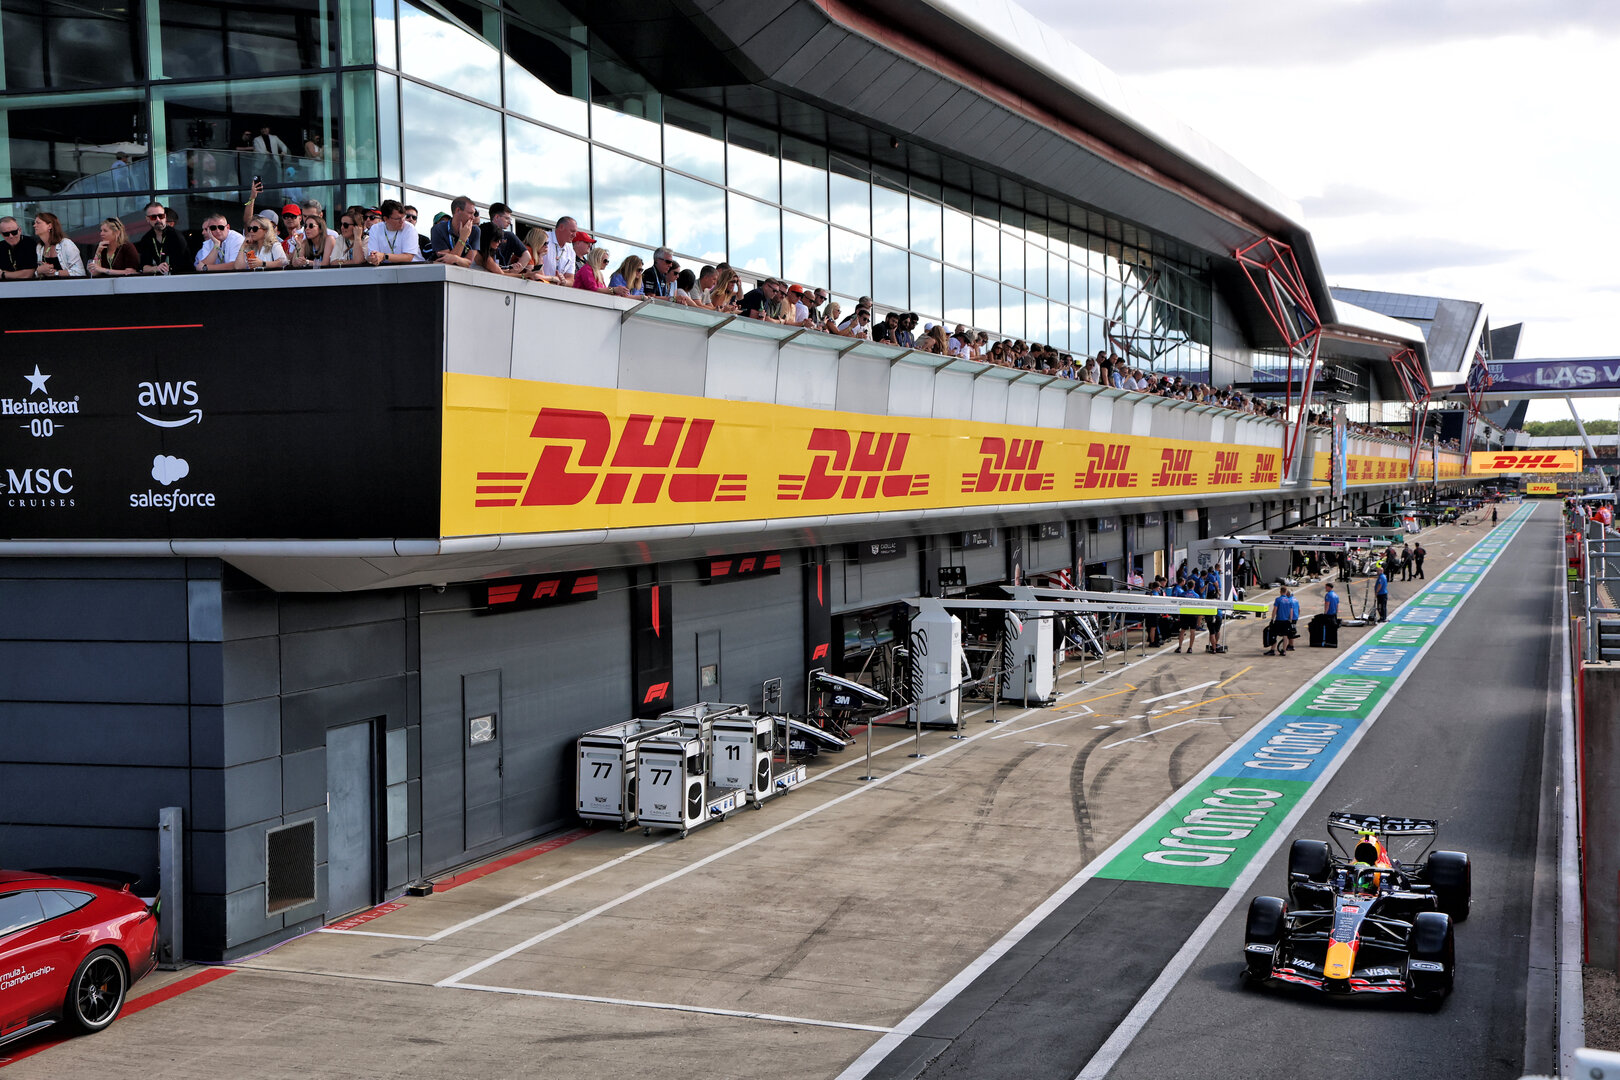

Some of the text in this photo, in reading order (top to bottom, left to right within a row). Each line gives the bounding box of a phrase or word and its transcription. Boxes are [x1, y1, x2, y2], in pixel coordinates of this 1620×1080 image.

[1536, 366, 1597, 385] LAS
[138, 380, 199, 406] aws
[1, 396, 79, 414] Heineken
[31, 418, 54, 437] 0.0
[520, 407, 719, 506] DHL
[801, 428, 913, 500] DHL
[975, 437, 1044, 493] DHL
[1084, 443, 1131, 489] DHL
[1159, 448, 1193, 486] DHL
[1492, 455, 1561, 468] DHL
[1212, 452, 1240, 485] DHL
[6, 468, 74, 494] MSC
[8, 499, 75, 507] CRUISES
[130, 489, 215, 512] salesforce
[532, 580, 560, 599] F1
[812, 643, 829, 660] F1
[911, 628, 928, 712] Cadilla
[643, 682, 670, 703] F1
[834, 695, 851, 705] 3M
[1305, 678, 1381, 712] aramco
[725, 745, 740, 760] 11
[789, 740, 806, 749] 3M
[1243, 721, 1343, 771] aramco
[591, 762, 612, 778] 77
[651, 769, 672, 786] 77
[1142, 787, 1284, 867] aramco
[1292, 957, 1316, 970] VISA
[1365, 968, 1392, 976] VISA
[1, 966, 51, 990] Championship
